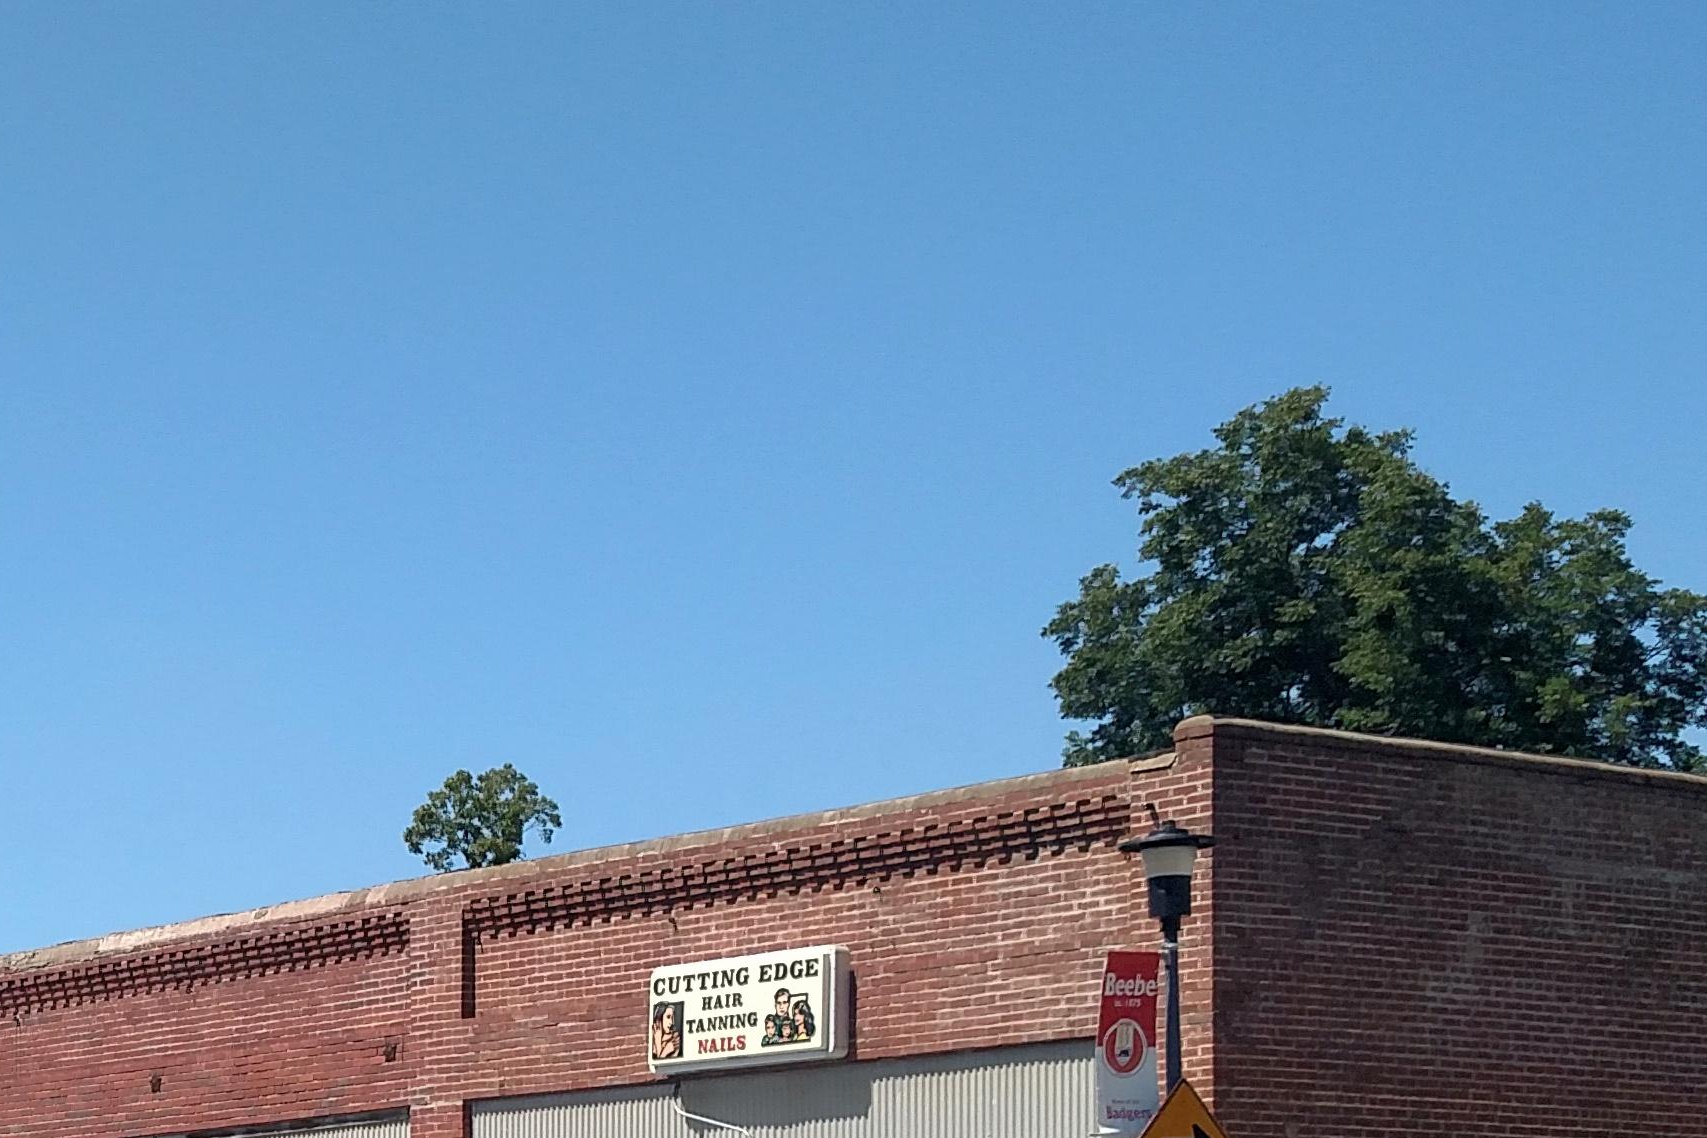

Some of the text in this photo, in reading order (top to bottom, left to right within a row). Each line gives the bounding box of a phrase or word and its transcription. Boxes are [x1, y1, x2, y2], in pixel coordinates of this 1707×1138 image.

[653, 958, 820, 997] CUTTING EDGE
[1104, 972, 1158, 997] Beebe
[701, 993, 744, 1011] HAIR
[685, 1011, 759, 1034] TANNING
[697, 1035, 747, 1054] NAILS
